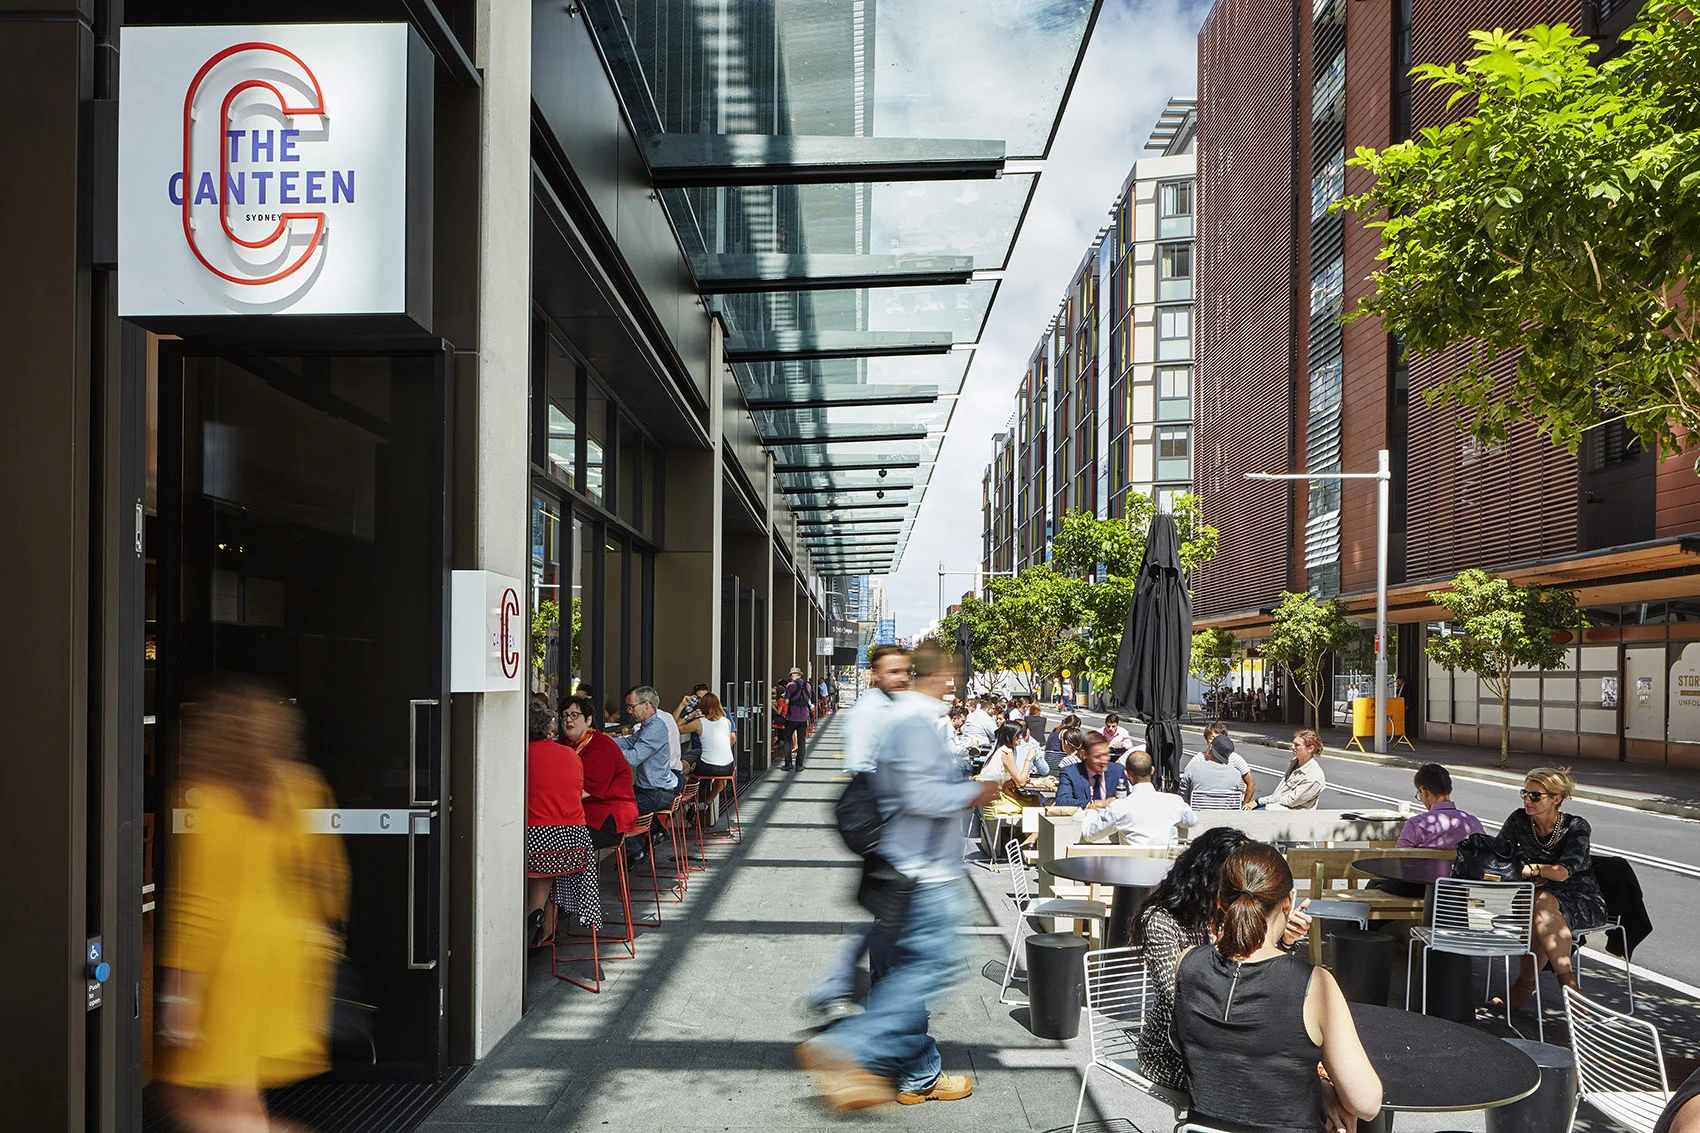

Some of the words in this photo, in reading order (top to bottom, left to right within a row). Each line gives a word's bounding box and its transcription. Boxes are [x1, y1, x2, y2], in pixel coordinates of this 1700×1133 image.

[227, 129, 300, 163] THE
[168, 170, 355, 206] CANTEEN
[246, 213, 283, 222] SYDNEY
[331, 813, 341, 829] C
[380, 813, 391, 829] C
